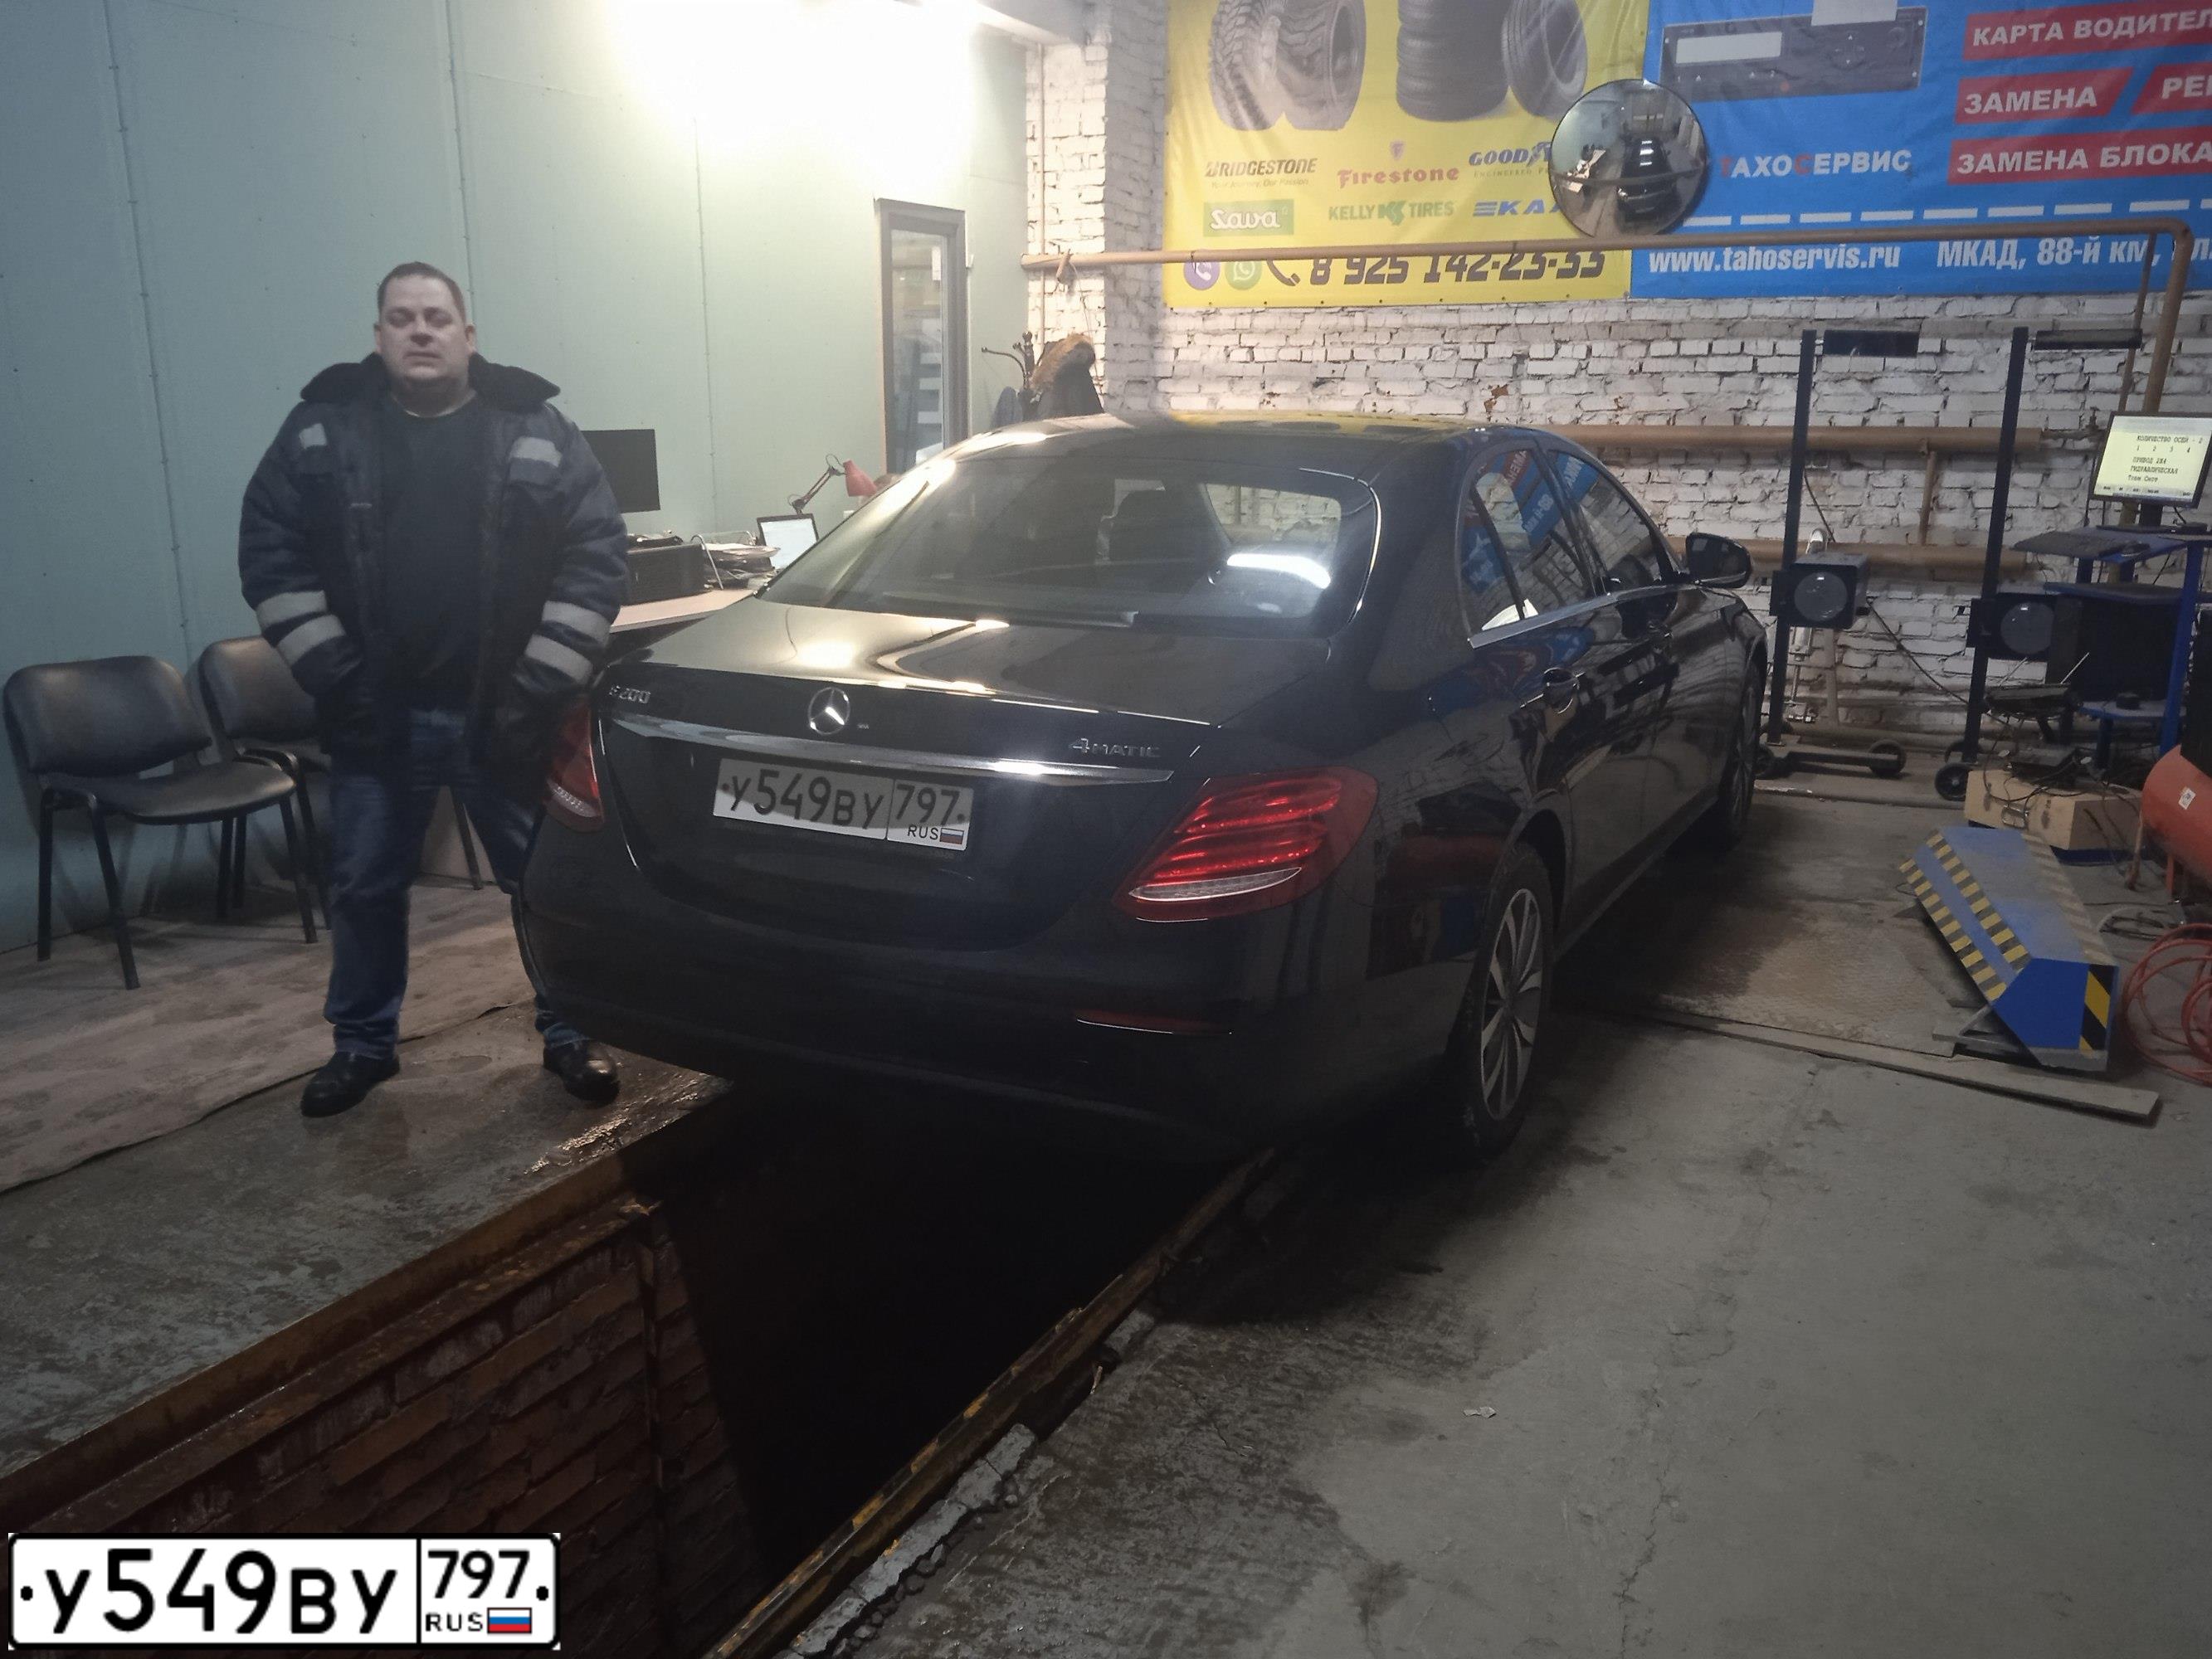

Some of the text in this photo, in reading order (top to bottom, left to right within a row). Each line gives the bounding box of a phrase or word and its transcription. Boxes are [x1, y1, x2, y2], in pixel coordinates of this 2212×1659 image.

[1972, 22, 2064, 46] КАРТА
[1964, 85, 2098, 114] ЗАМЕНА
[2161, 75, 2212, 100] РЕ
[1205, 158, 1318, 178] BRIDGESTONE
[1720, 149, 1912, 178] ТАХОСЕРВИС
[1956, 141, 2212, 174] ЗАМЕНА БЛОКА
[1337, 167, 1460, 189] Firestone
[1328, 204, 1376, 221] KELLY
[1408, 202, 1454, 218] TIRES
[1649, 244, 1901, 273] www.tahoservis.ru
[1937, 238, 2026, 270] МКАД,
[2037, 235, 2102, 265] 88-й
[1310, 256, 1332, 285] 8
[1344, 255, 1409, 285] 925
[730, 768, 960, 830] У549ВУ 797
[907, 825, 939, 840] RUS
